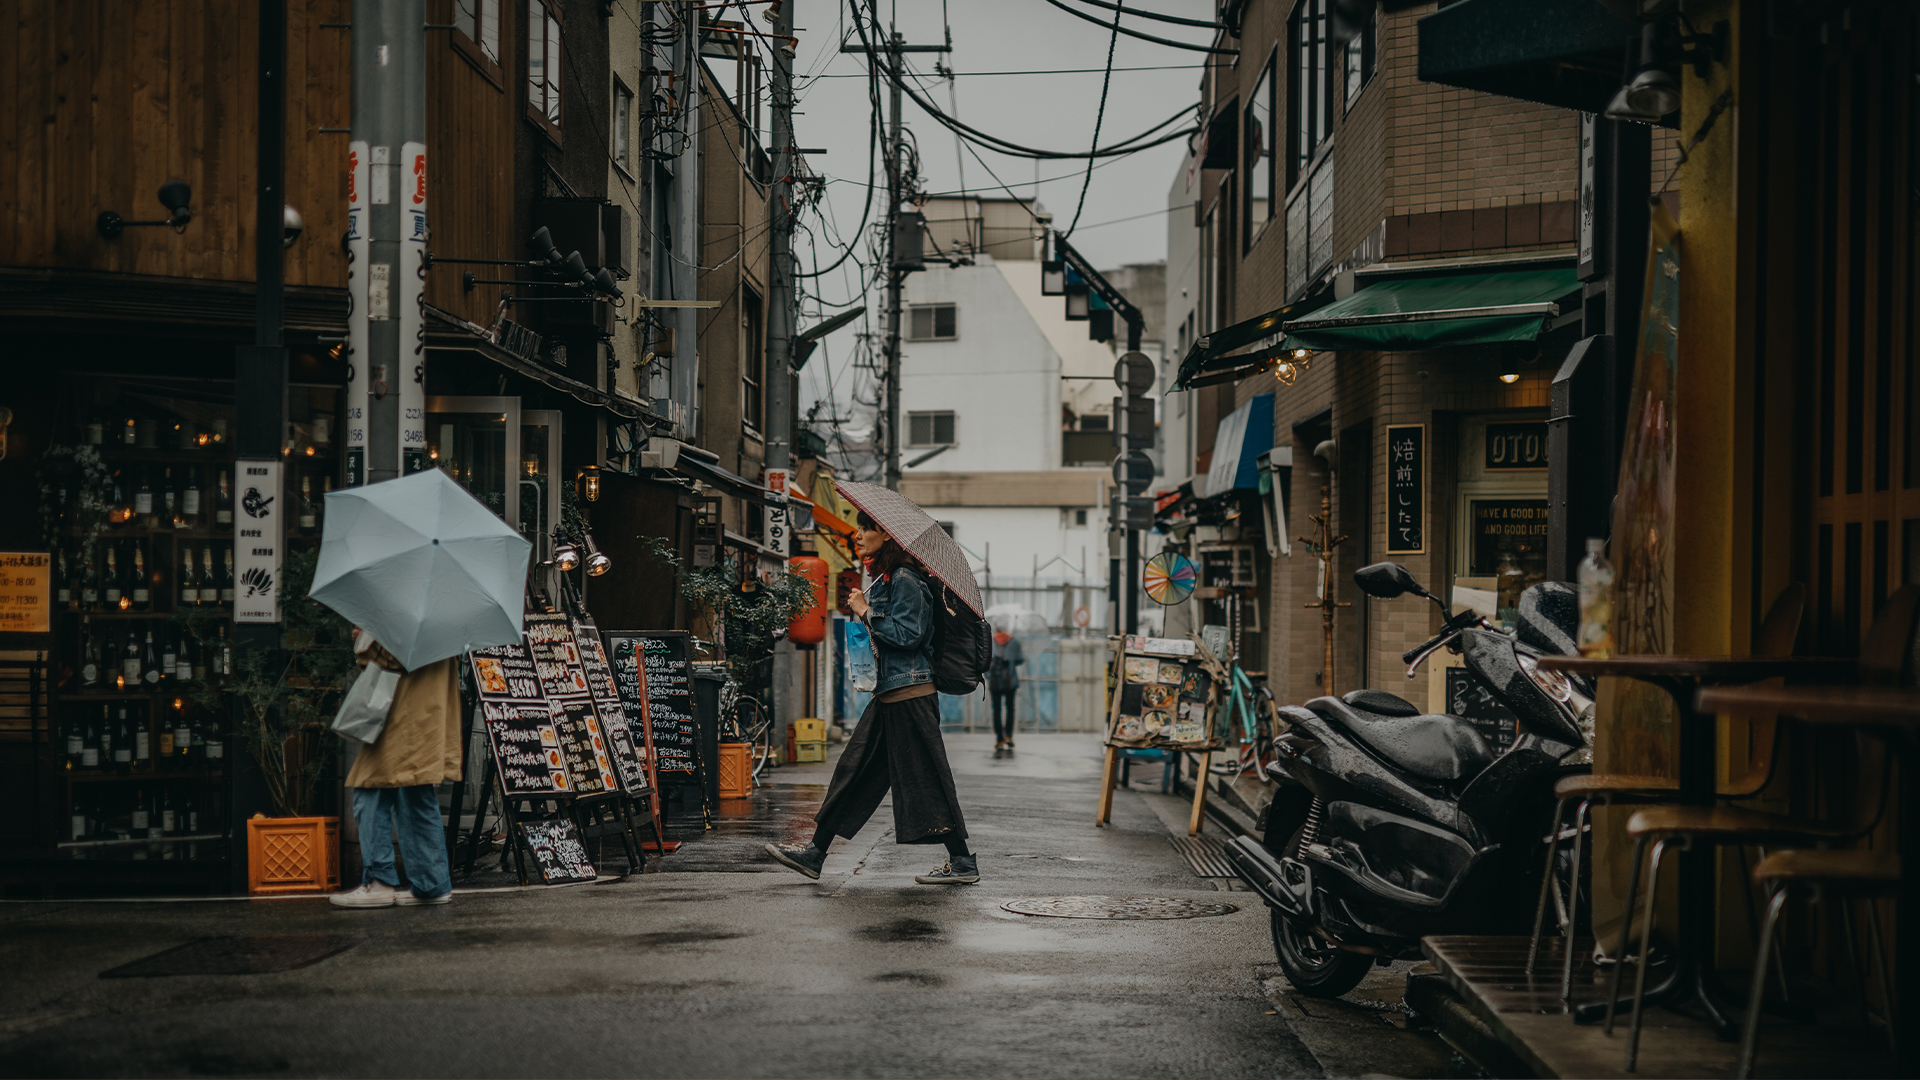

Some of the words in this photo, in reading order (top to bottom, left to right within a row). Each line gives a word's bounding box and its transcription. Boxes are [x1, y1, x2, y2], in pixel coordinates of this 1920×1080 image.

[1393, 438, 1416, 543] 焙煎したて
[1477, 508, 1500, 519] HAVE
[1502, 508, 1508, 519] A
[1510, 508, 1534, 519] GOOD
[1485, 524, 1502, 535] AND
[1504, 524, 1527, 535] GOOD
